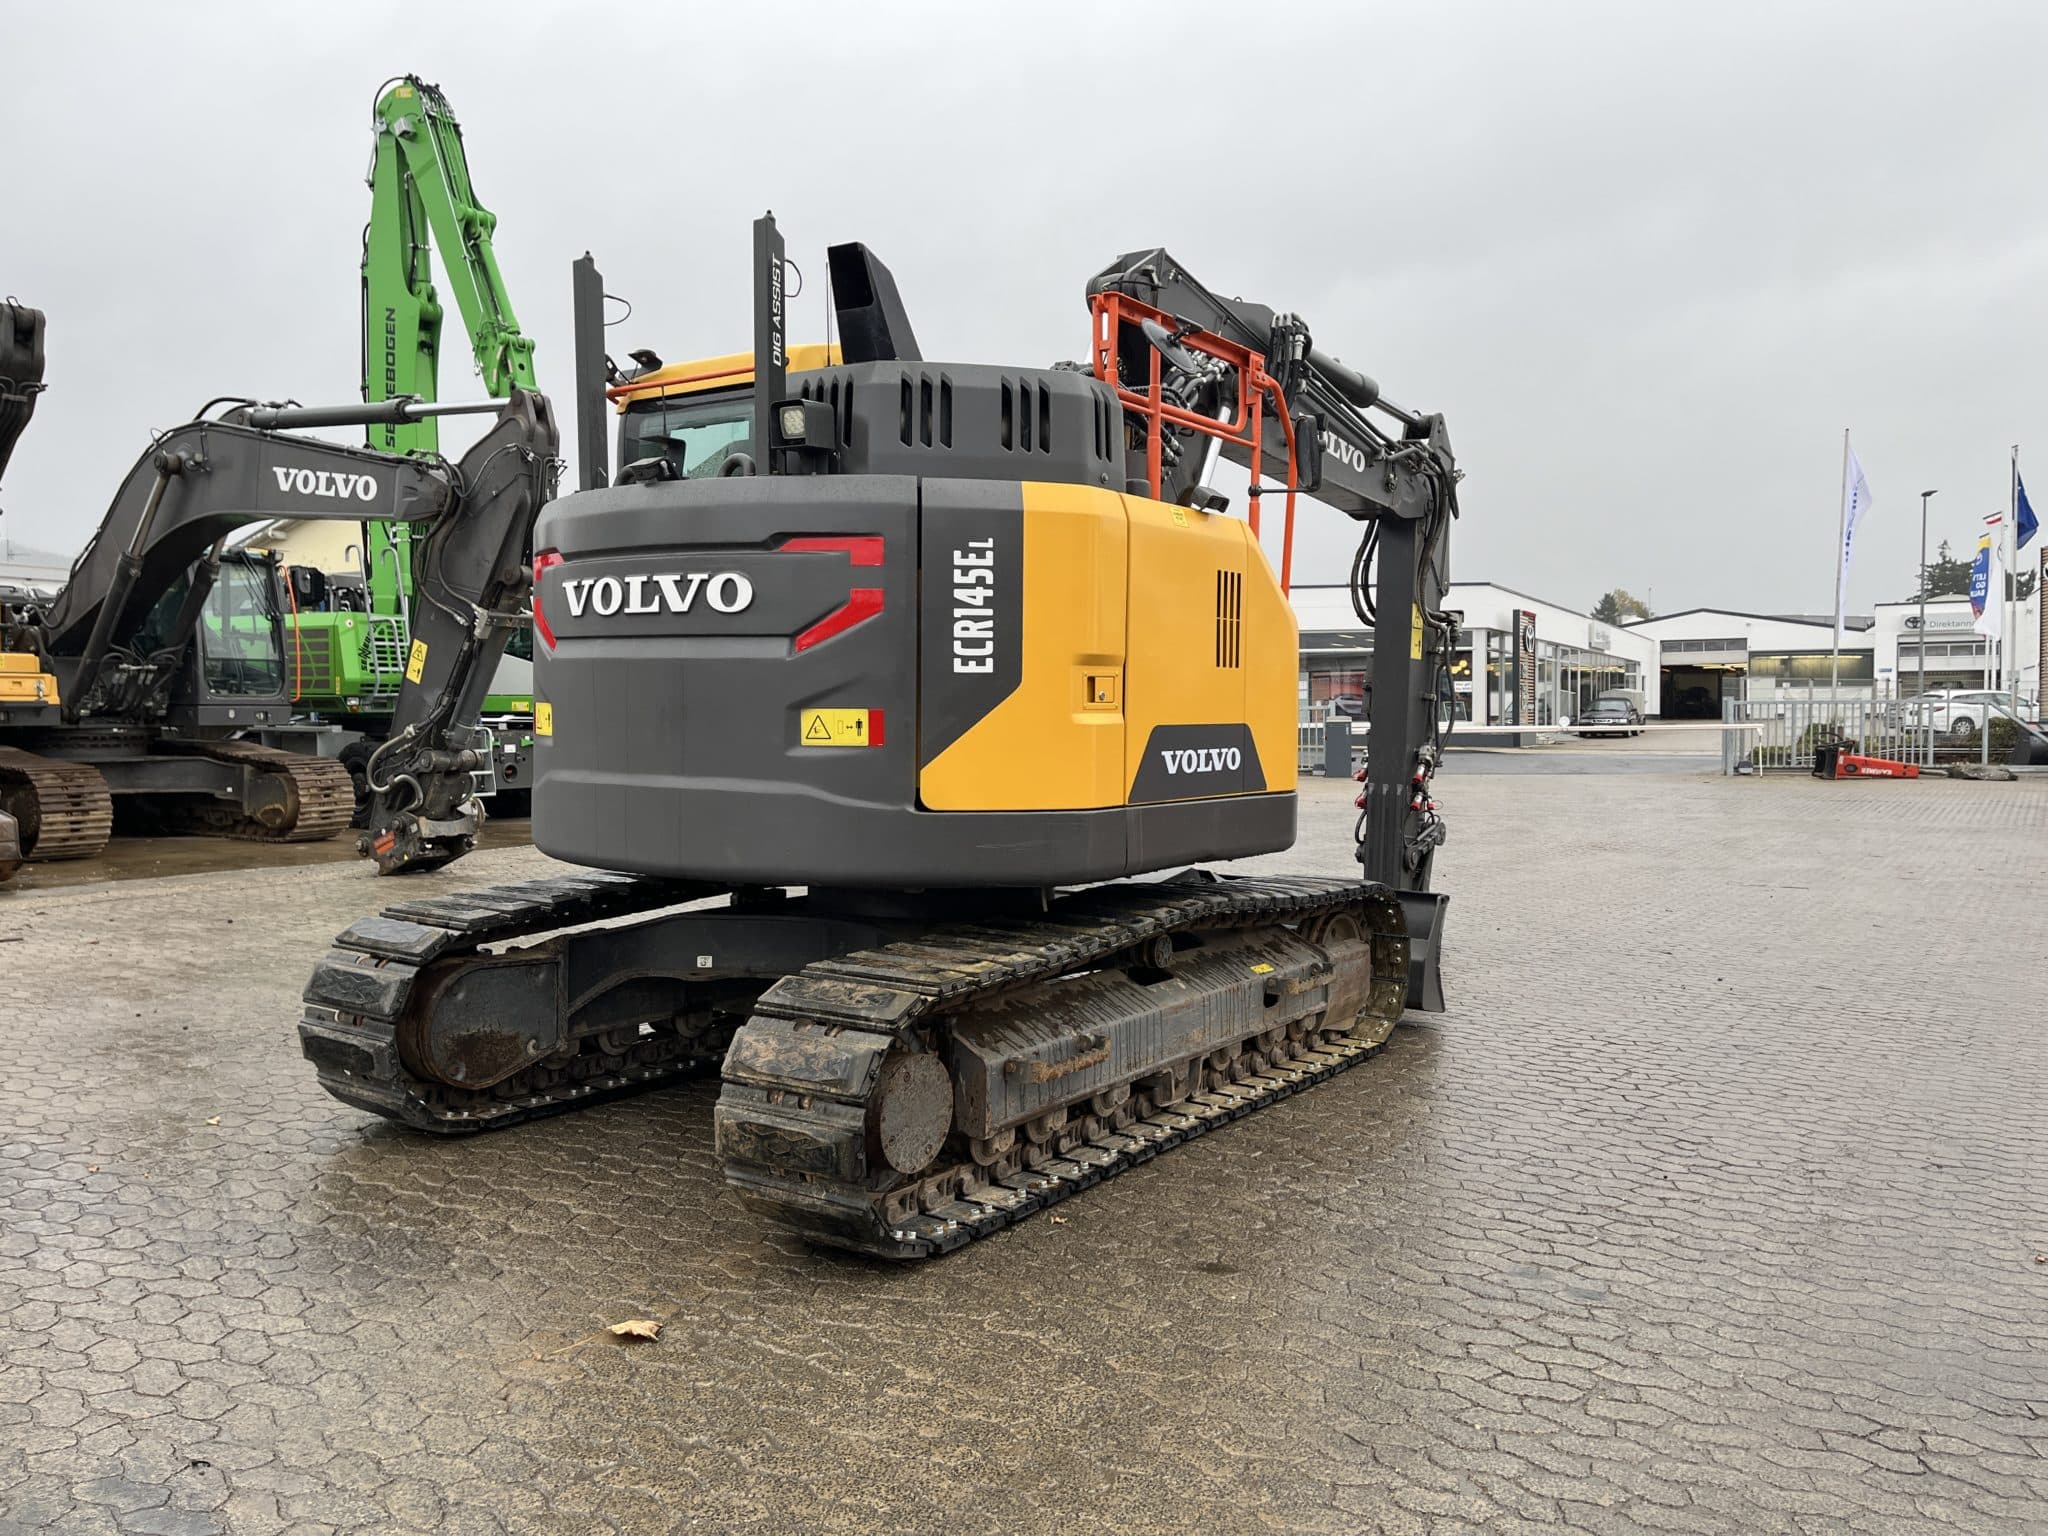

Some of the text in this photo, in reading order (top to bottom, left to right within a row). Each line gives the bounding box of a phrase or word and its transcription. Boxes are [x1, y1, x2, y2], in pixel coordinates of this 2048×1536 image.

[772, 252, 782, 367] DIG ASSIST
[385, 307, 396, 448] SEEBOGEN
[1310, 424, 1365, 472] LVO
[272, 466, 378, 501] VOLVO
[562, 573, 753, 616] VOLVO
[953, 537, 994, 673] ECR145EL
[1161, 747, 1241, 775] VOLVO
